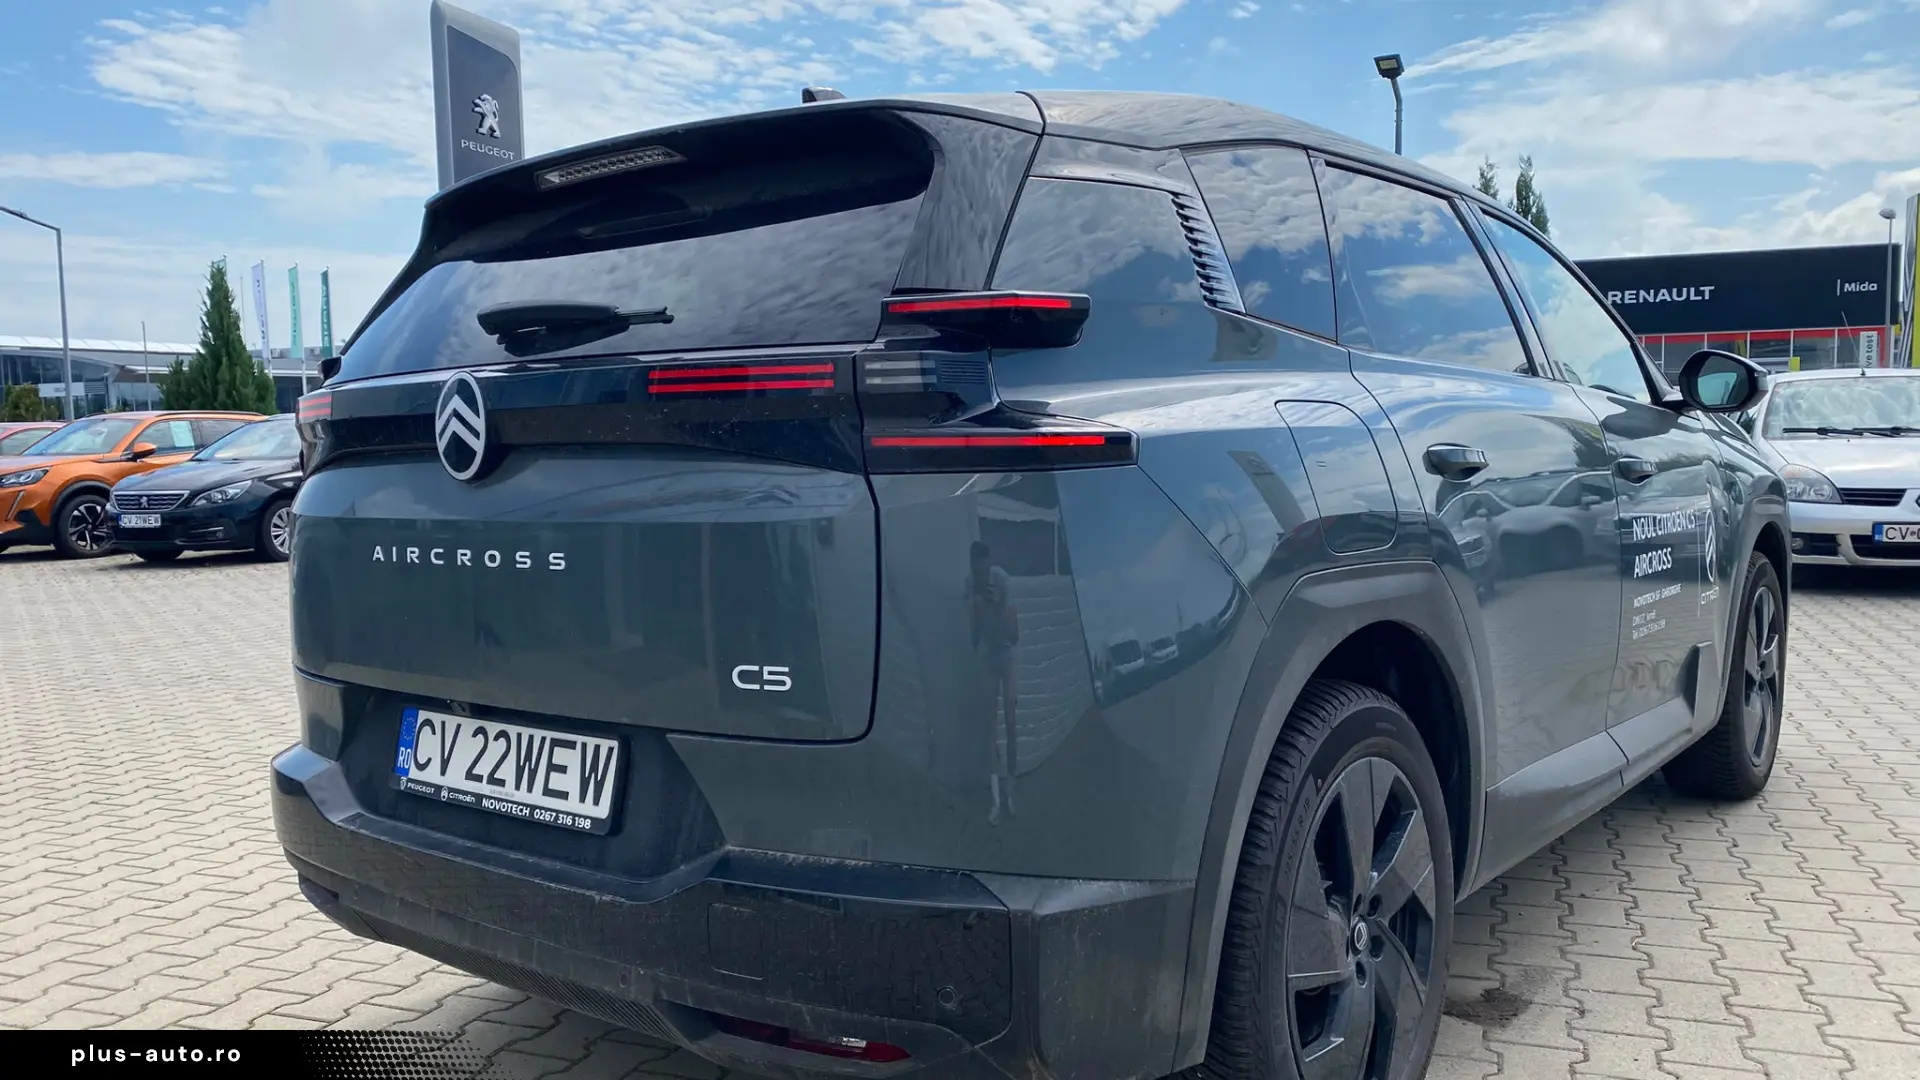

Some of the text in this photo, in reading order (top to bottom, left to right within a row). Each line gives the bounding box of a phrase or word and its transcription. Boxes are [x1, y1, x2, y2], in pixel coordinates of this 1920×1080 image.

[461, 139, 515, 160] PEUGEOT
[1607, 286, 1715, 304] RENAULT
[1843, 280, 1878, 293] Mida
[1865, 334, 1874, 354] test
[1632, 516, 1656, 541] NOUL
[1885, 526, 1910, 540] CV
[372, 545, 566, 571] AIRCROSS
[1633, 547, 1672, 578] AIRCROSS
[731, 665, 792, 691] C5
[397, 747, 412, 769] RO
[413, 718, 615, 807] CV 22WEW
[407, 782, 435, 794] PEUGEOT
[482, 798, 591, 830] NOVOTECH 0267 316 198
